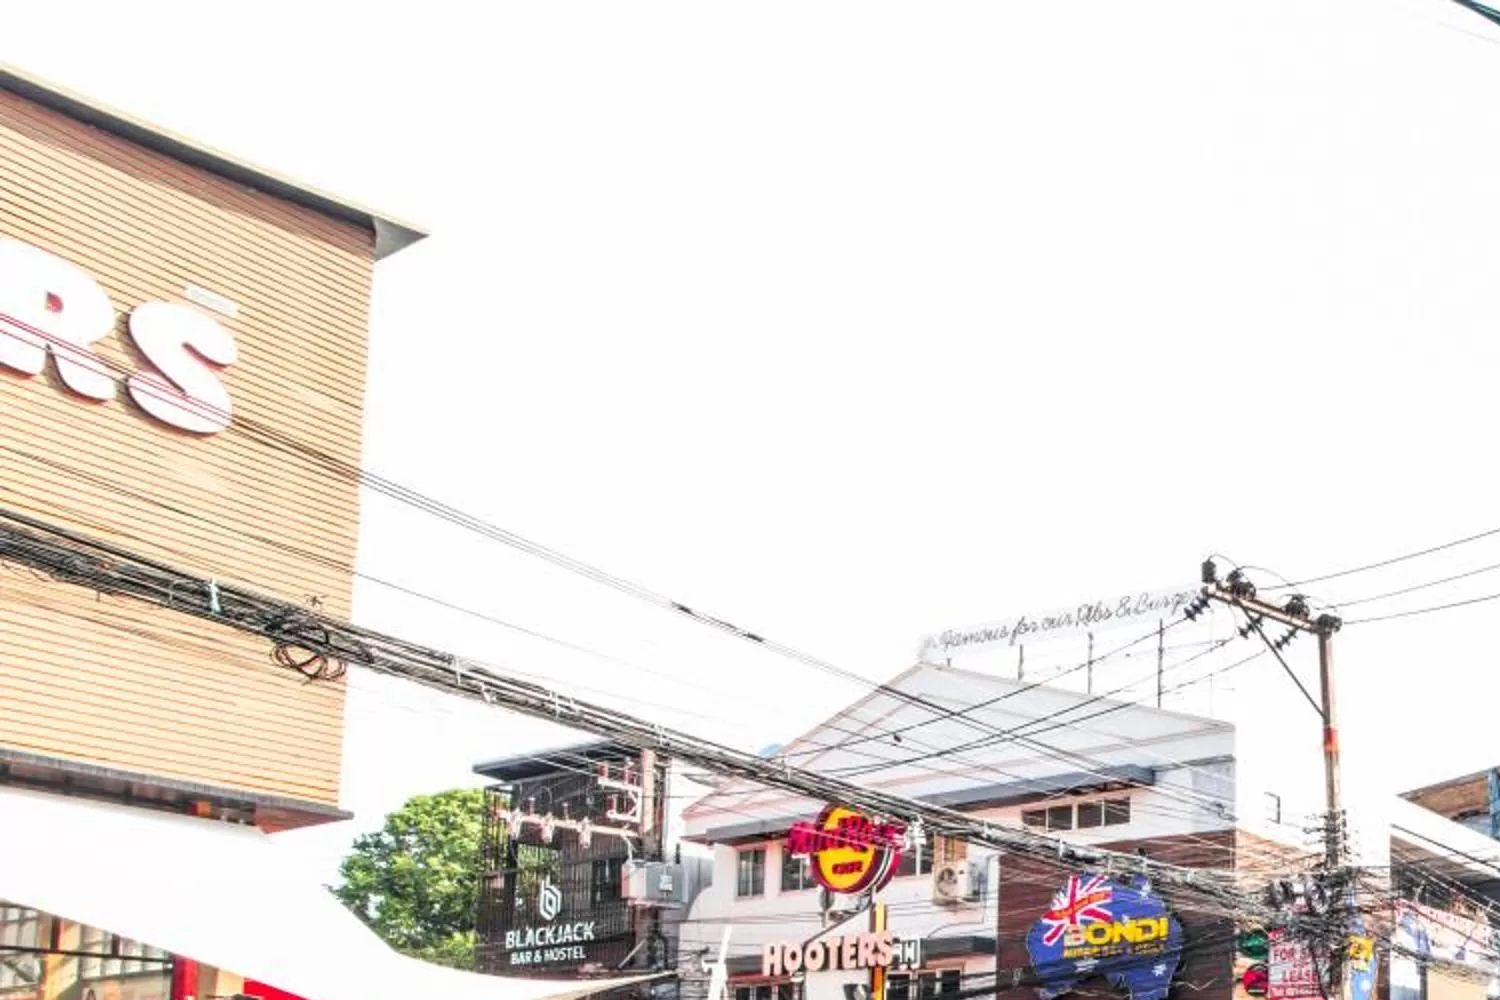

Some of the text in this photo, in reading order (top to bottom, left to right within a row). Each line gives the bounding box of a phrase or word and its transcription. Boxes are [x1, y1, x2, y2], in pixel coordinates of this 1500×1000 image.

[505, 921, 595, 949] BLACKJACK
[511, 946, 586, 965] BAR & HOSTEL
[763, 932, 894, 977] HOOTERS
